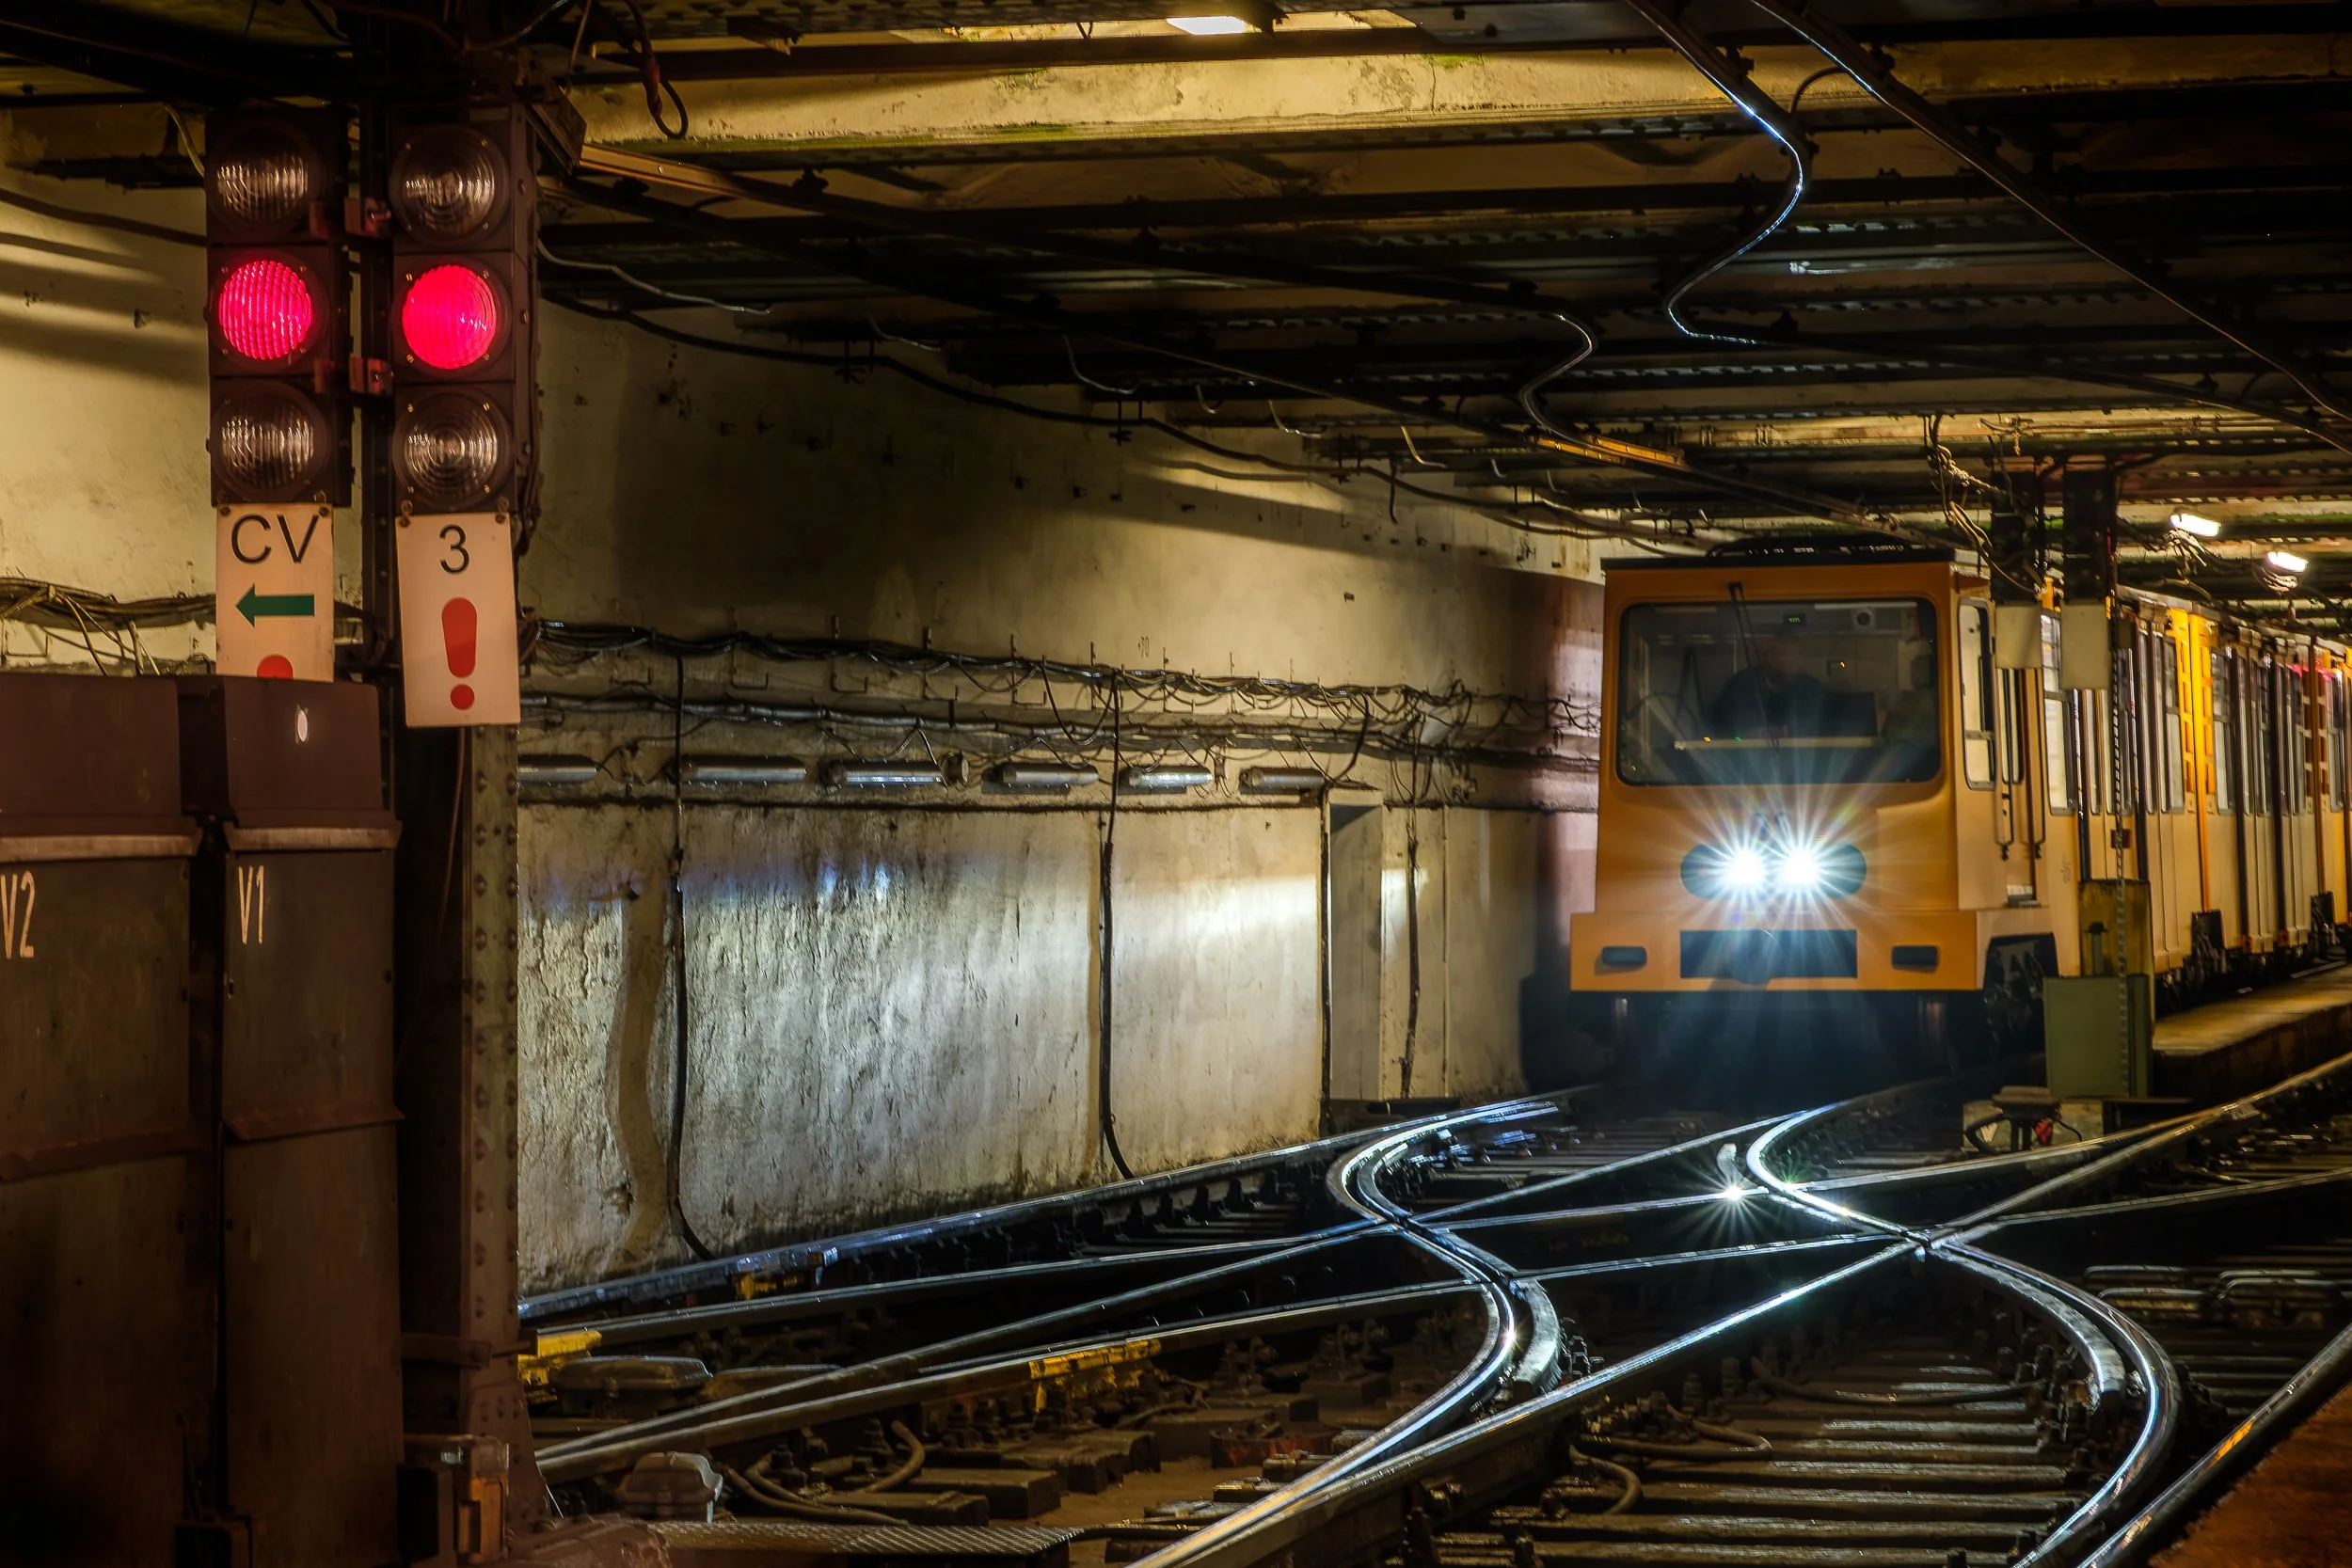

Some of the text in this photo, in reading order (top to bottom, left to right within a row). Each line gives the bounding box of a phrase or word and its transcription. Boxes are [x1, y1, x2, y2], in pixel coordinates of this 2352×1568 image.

[230, 513, 320, 564] CV
[438, 524, 470, 575] 3
[0, 870, 36, 959] V2
[238, 864, 264, 945] V1
